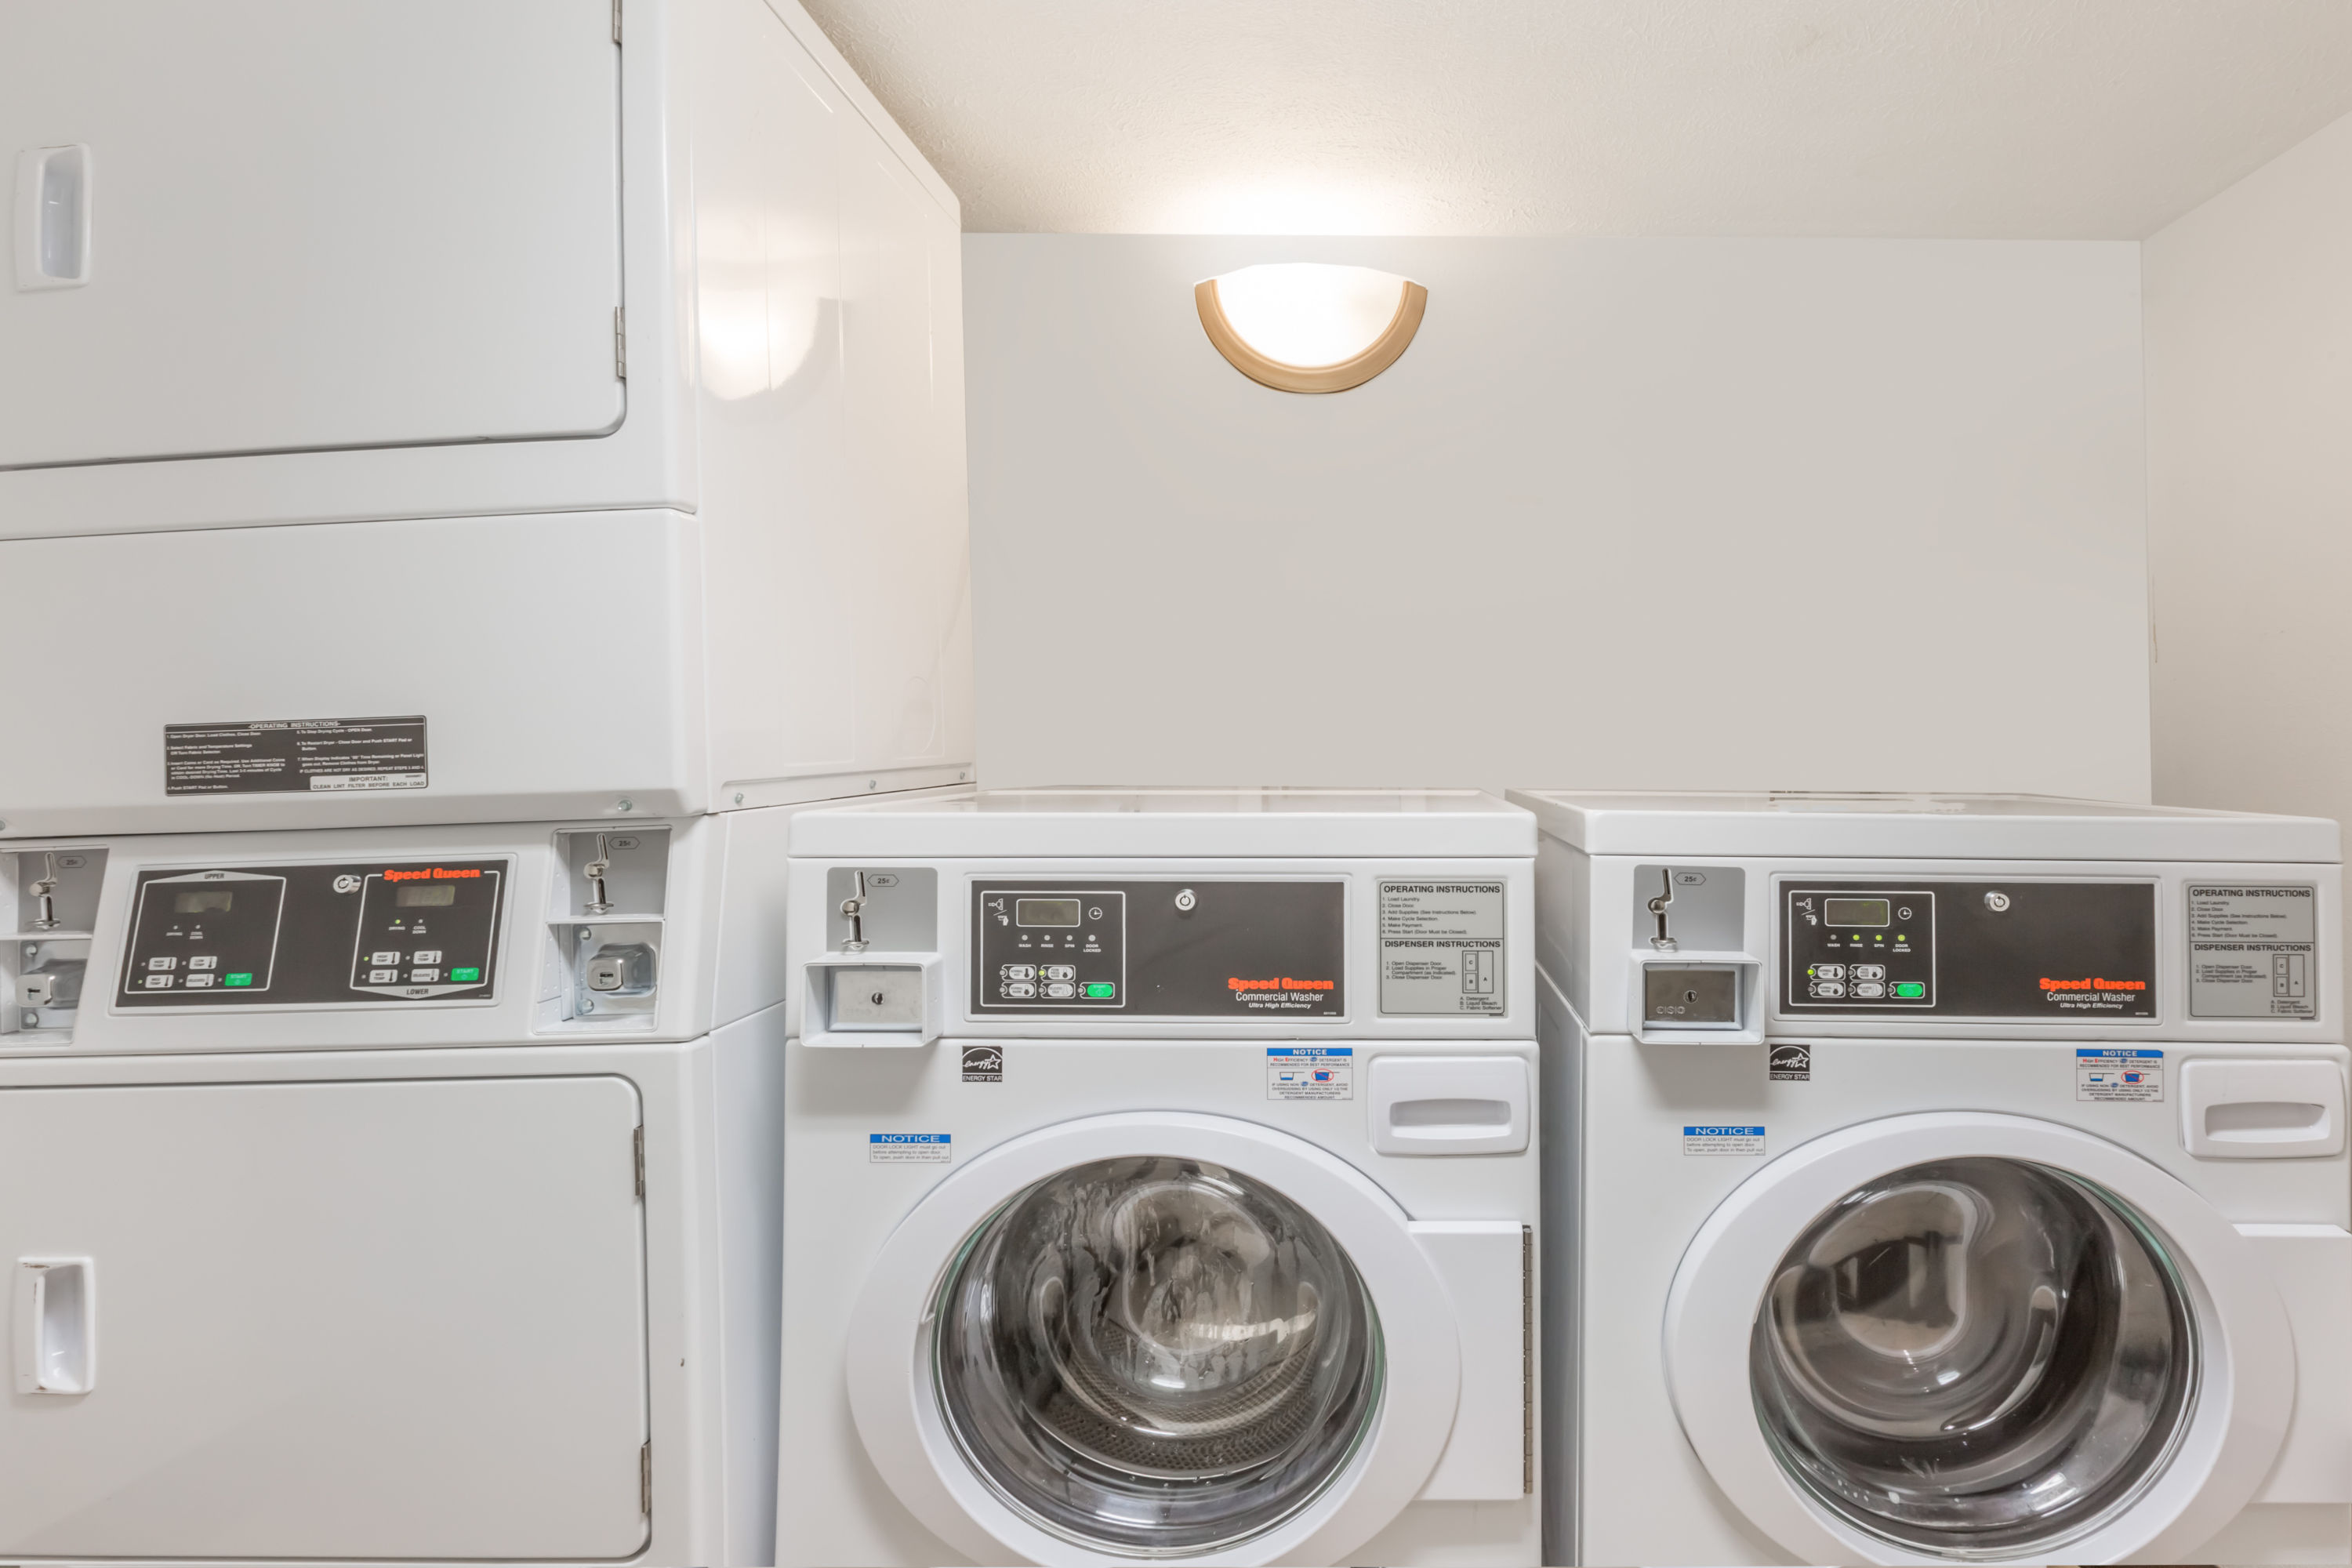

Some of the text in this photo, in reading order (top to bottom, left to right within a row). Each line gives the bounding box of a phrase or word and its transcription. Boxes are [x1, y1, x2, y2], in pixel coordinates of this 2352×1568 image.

[384, 868, 481, 883] Speed Queen
[1228, 977, 1334, 992] Speed Queen
[2039, 978, 2146, 992] Speed Queen
[1236, 992, 1324, 1002] Commercial Washer
[2046, 992, 2136, 1002] Commercial Washer
[881, 1134, 940, 1143] NOTICE
